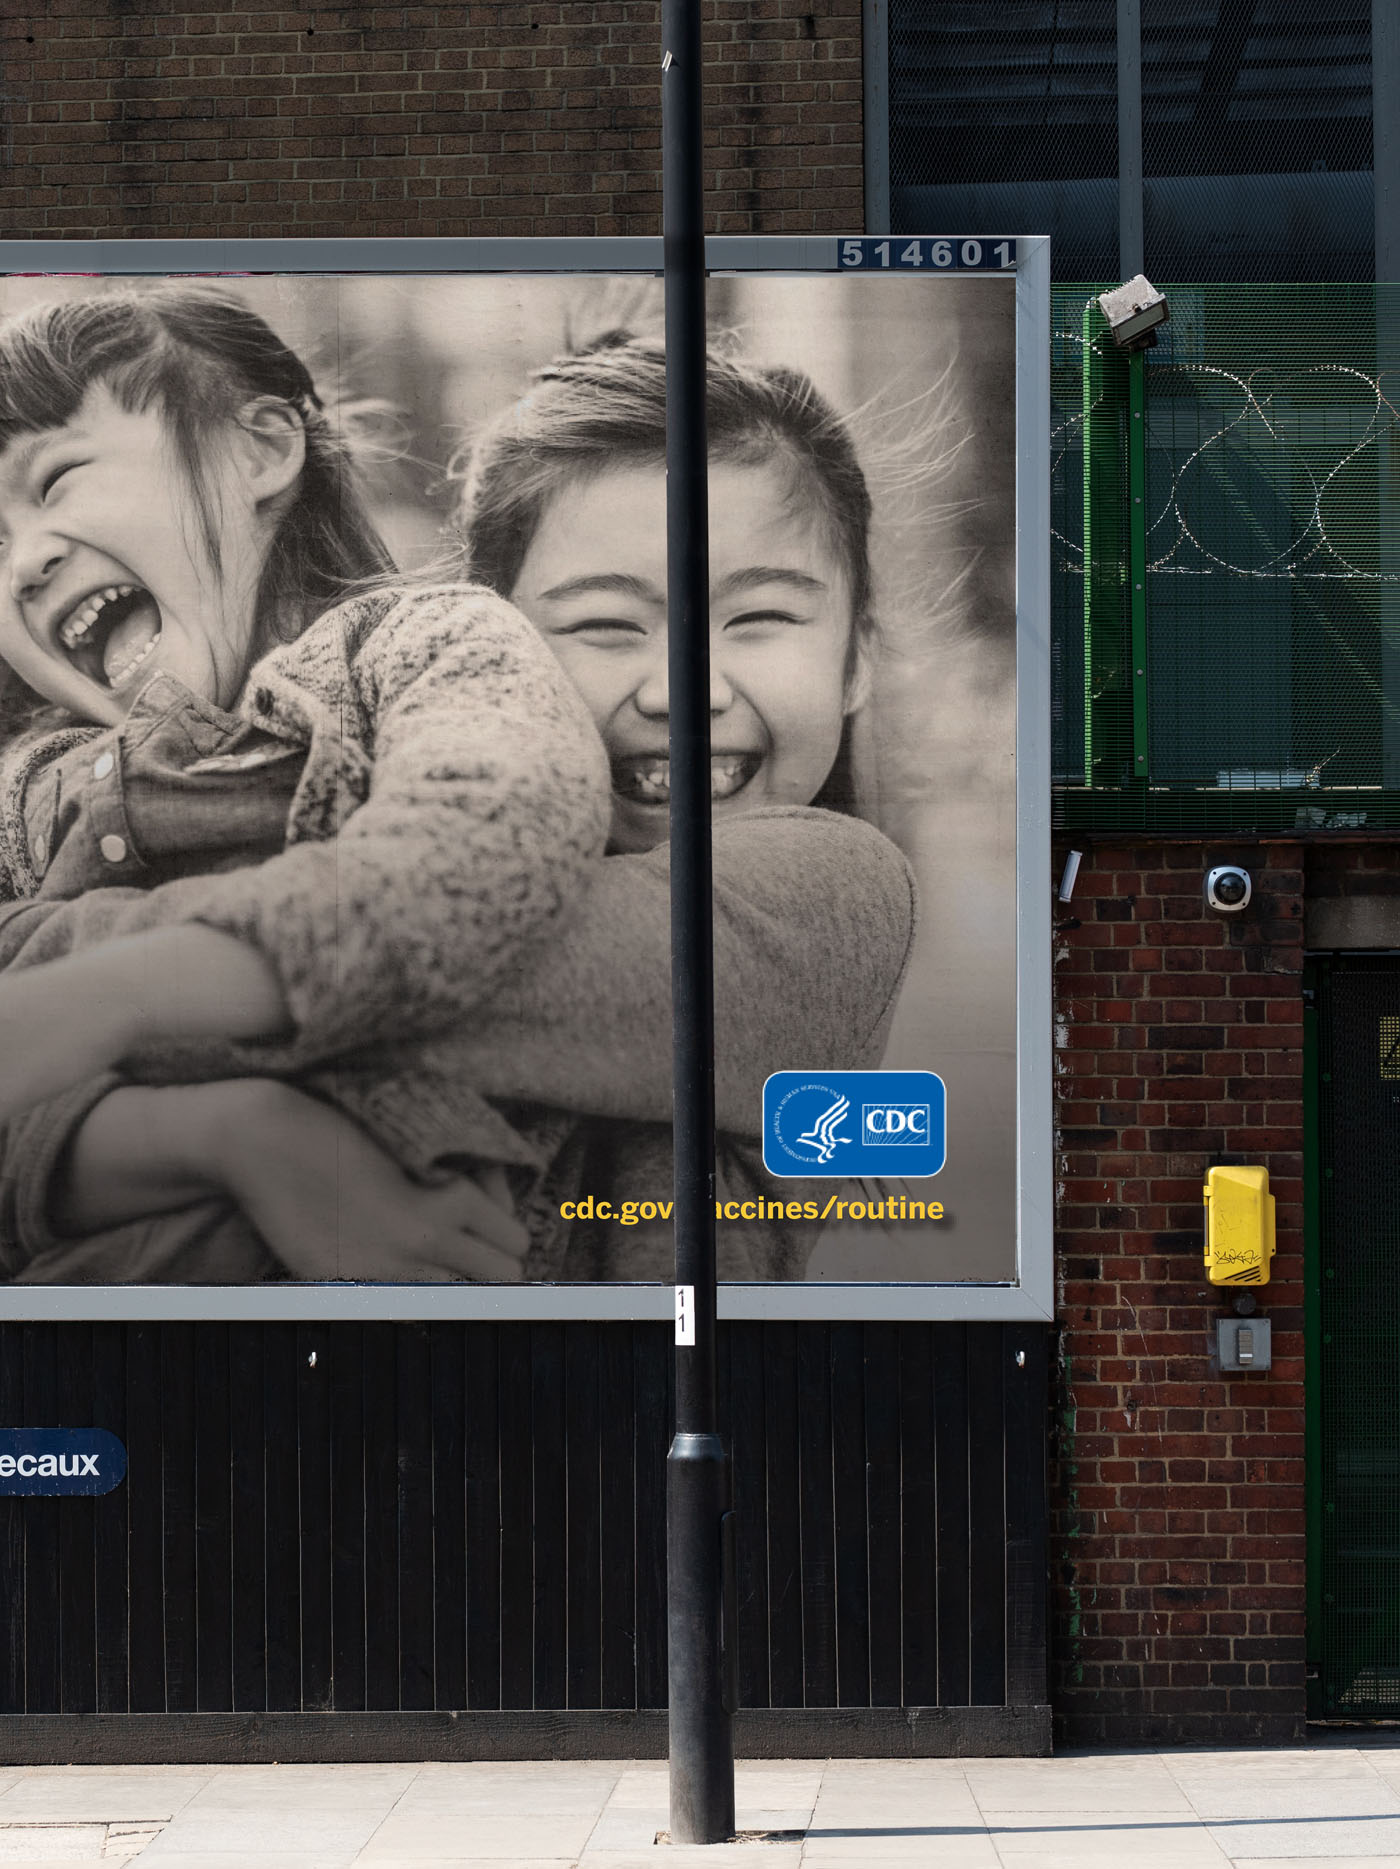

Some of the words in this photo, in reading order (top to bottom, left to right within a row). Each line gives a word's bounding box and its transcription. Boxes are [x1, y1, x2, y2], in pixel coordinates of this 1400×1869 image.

[842, 240, 1010, 267] 514601
[866, 1109, 926, 1133] CDC
[559, 1195, 945, 1226] cdc.govccines/routine
